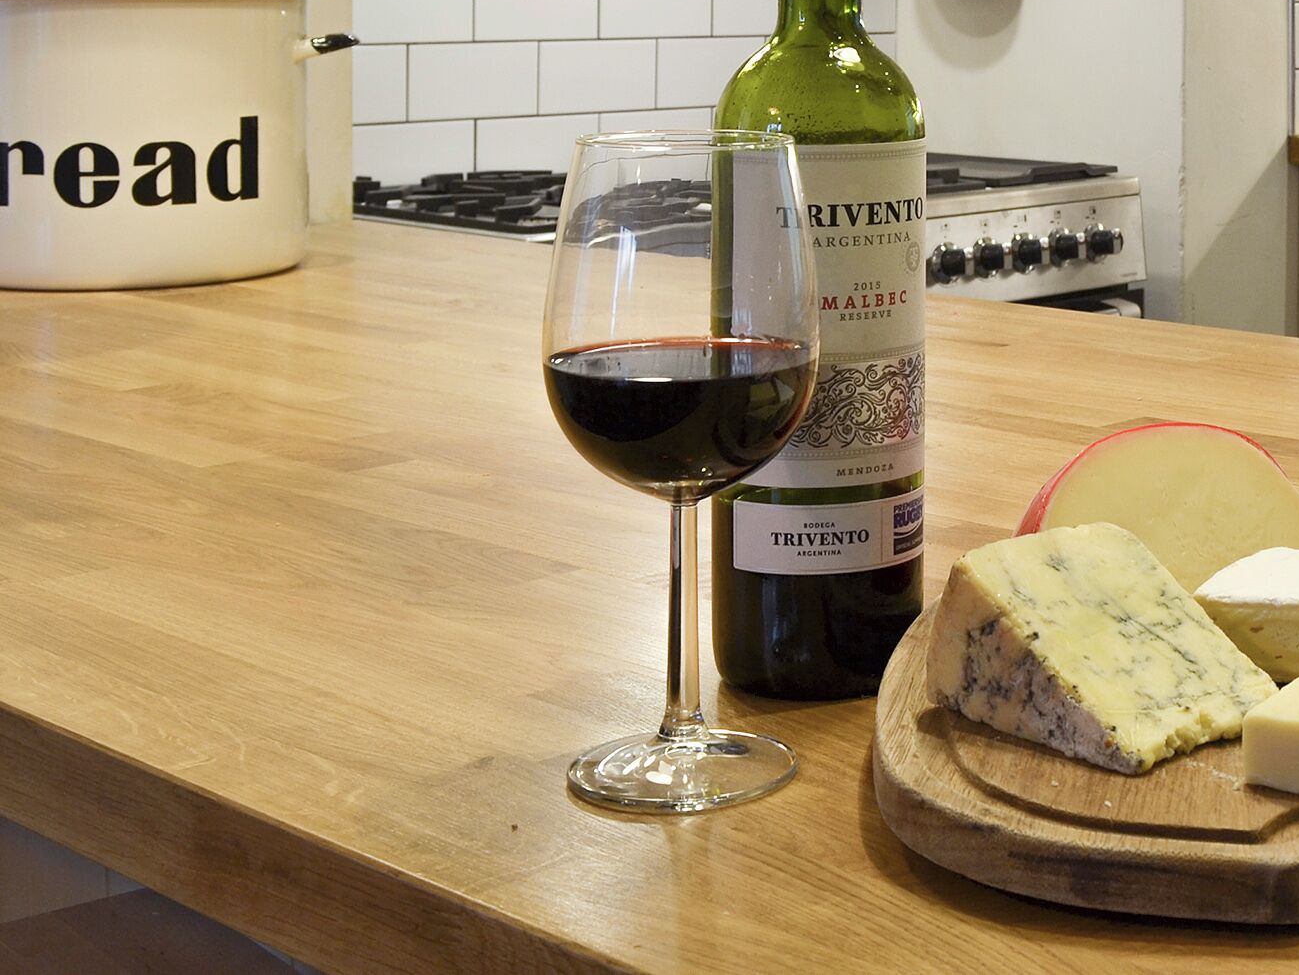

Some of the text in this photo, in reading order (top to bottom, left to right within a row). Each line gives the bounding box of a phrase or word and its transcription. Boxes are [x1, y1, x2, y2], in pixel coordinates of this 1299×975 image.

[776, 197, 923, 229] TRIVENTO
[812, 232, 911, 247] ARGENTINA
[853, 281, 881, 291] 2015
[821, 290, 907, 310] MALBEC
[839, 309, 892, 321] RESERVE
[836, 463, 894, 477] MENDOZA
[771, 529, 870, 547] TRIVENTO
[797, 549, 842, 557] ARGENTINA
